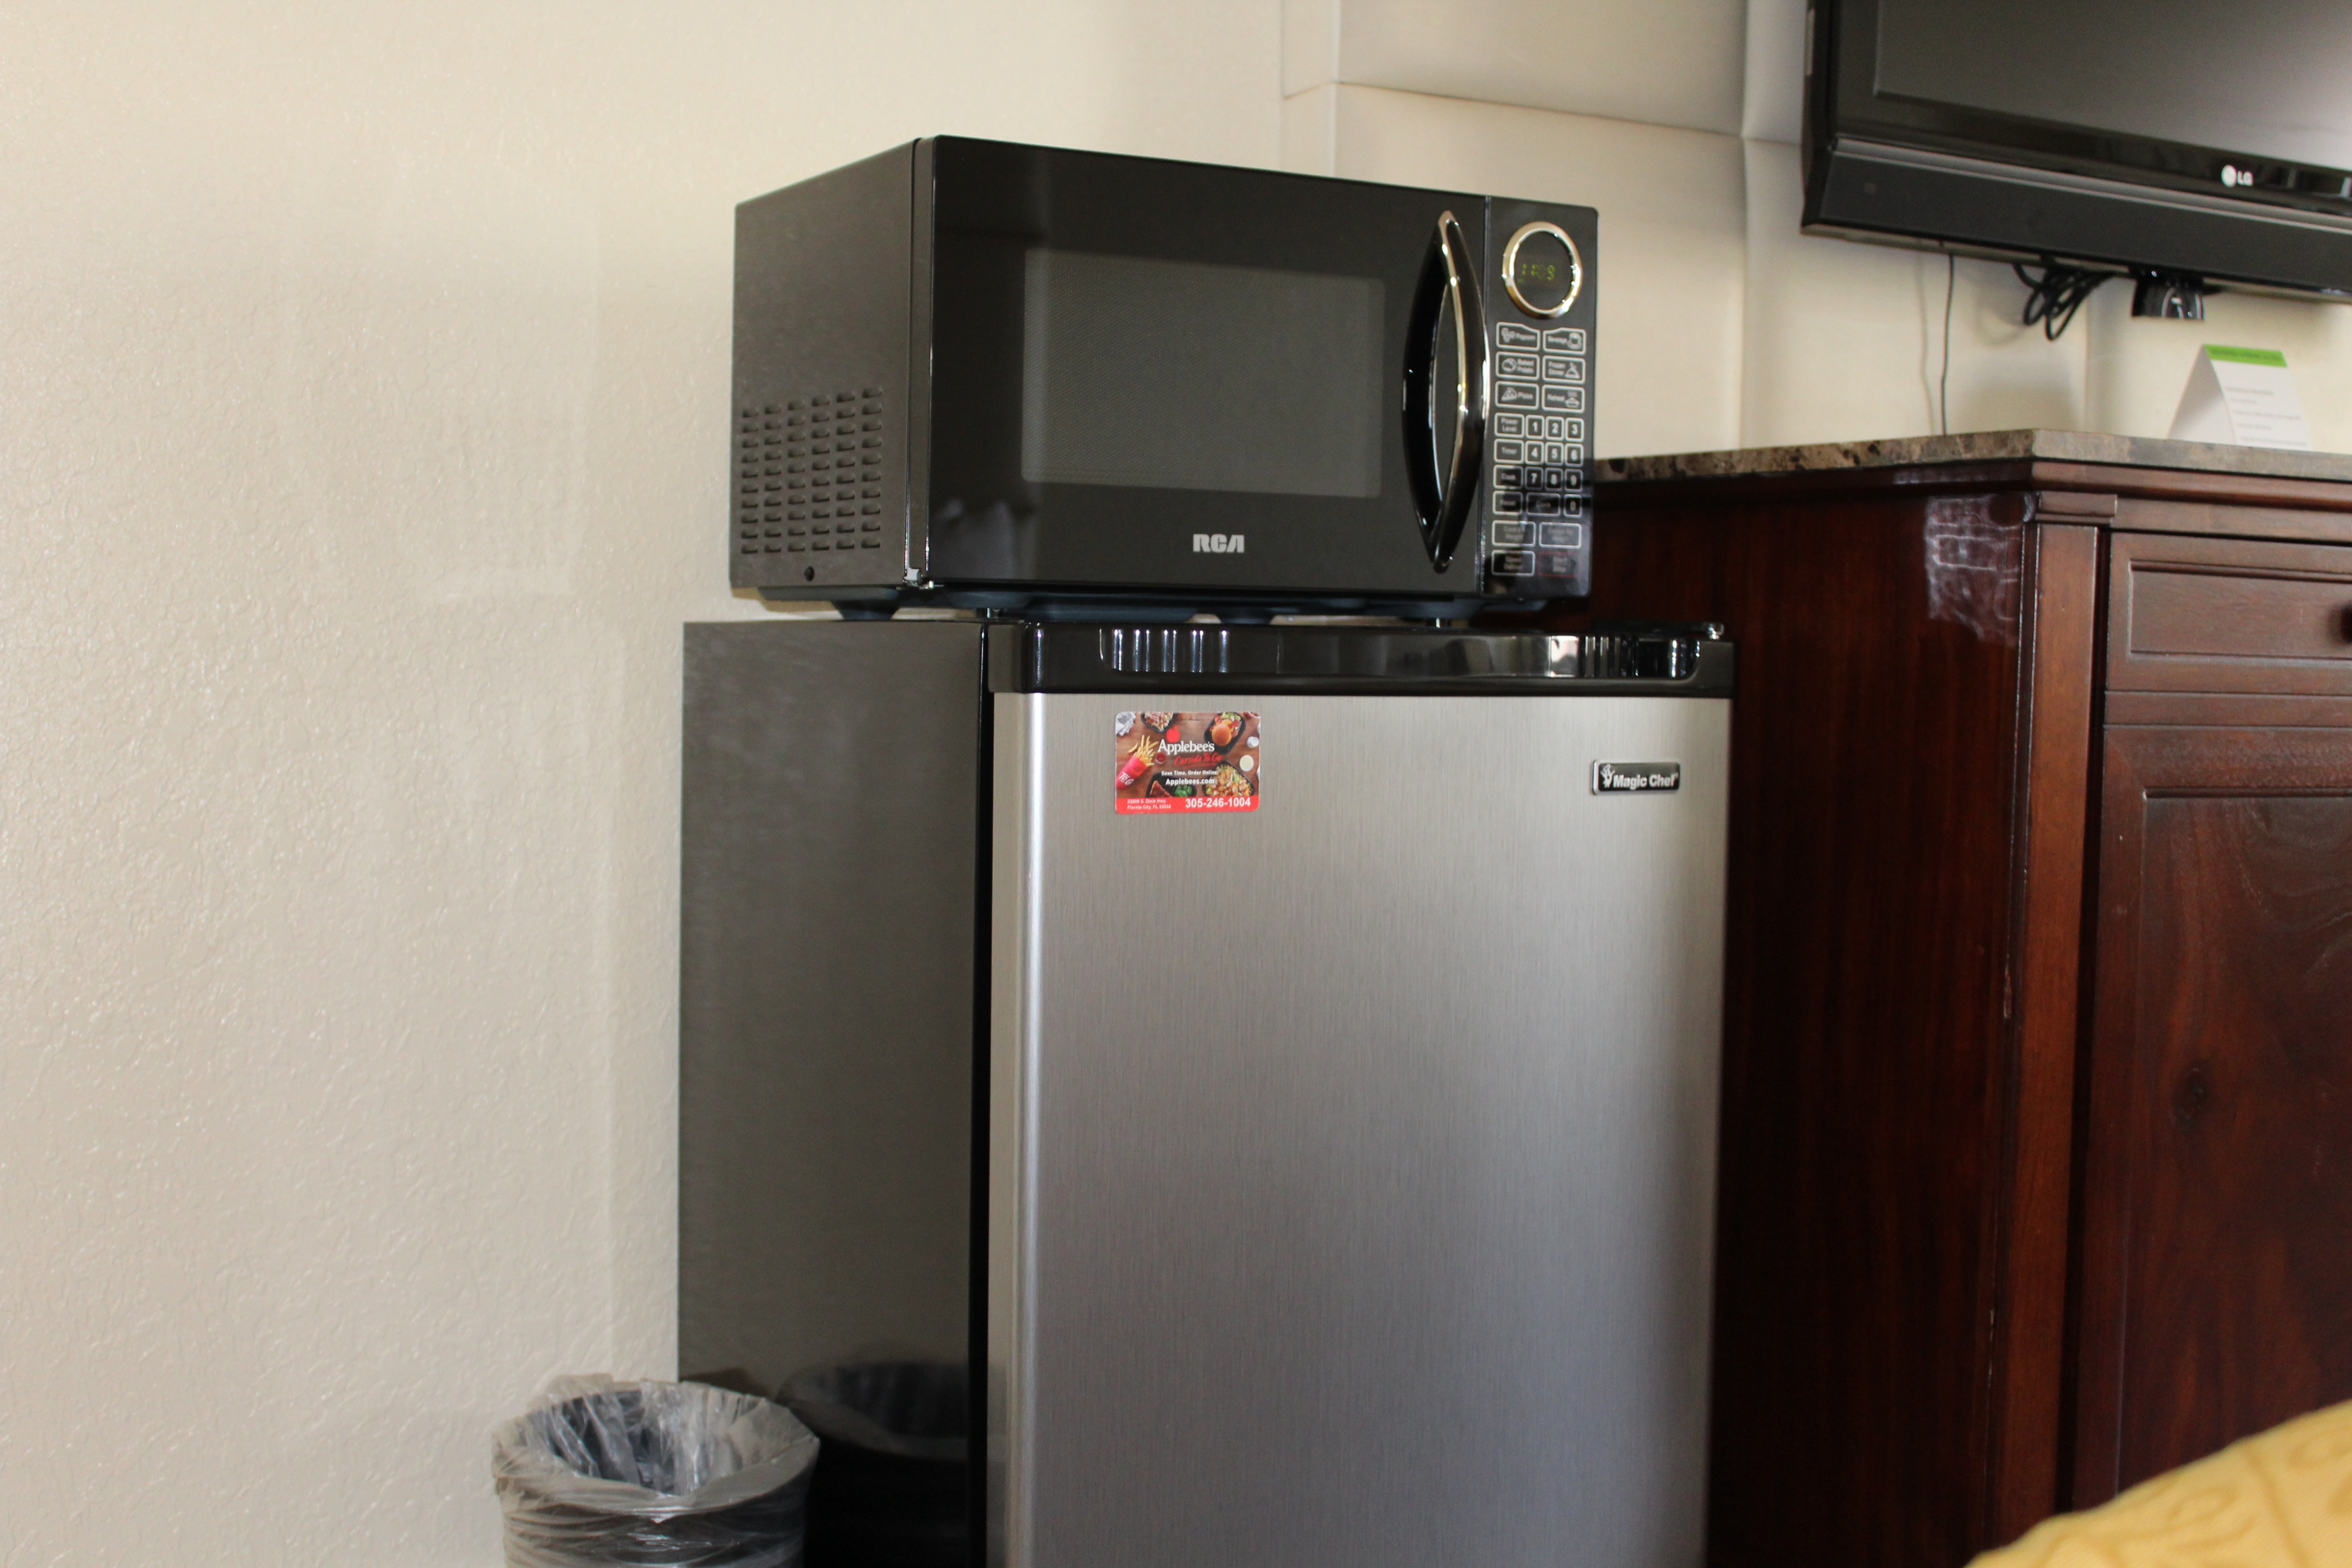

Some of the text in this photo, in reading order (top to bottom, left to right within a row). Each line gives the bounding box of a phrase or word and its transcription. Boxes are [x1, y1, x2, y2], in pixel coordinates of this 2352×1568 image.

[2238, 171, 2254, 186] LG
[1532, 421, 1538, 431] 1
[1551, 422, 1559, 434] 2
[1571, 424, 1578, 435] 3
[1531, 447, 1538, 458] 4
[1551, 448, 1558, 459] 5
[1571, 449, 1578, 461] 6
[1531, 473, 1538, 484] 7
[1550, 474, 1558, 485] 8
[1570, 475, 1578, 486] 9
[1570, 500, 1577, 511] 0
[1193, 534, 1245, 553] RCA
[1157, 739, 1215, 755] Applebee's
[1203, 753, 1211, 762] To
[1211, 752, 1223, 762] Go
[1165, 778, 1215, 786] Applebees.com
[1613, 772, 1678, 790] Magic Chef
[1185, 797, 1251, 808] 305-246-1004
